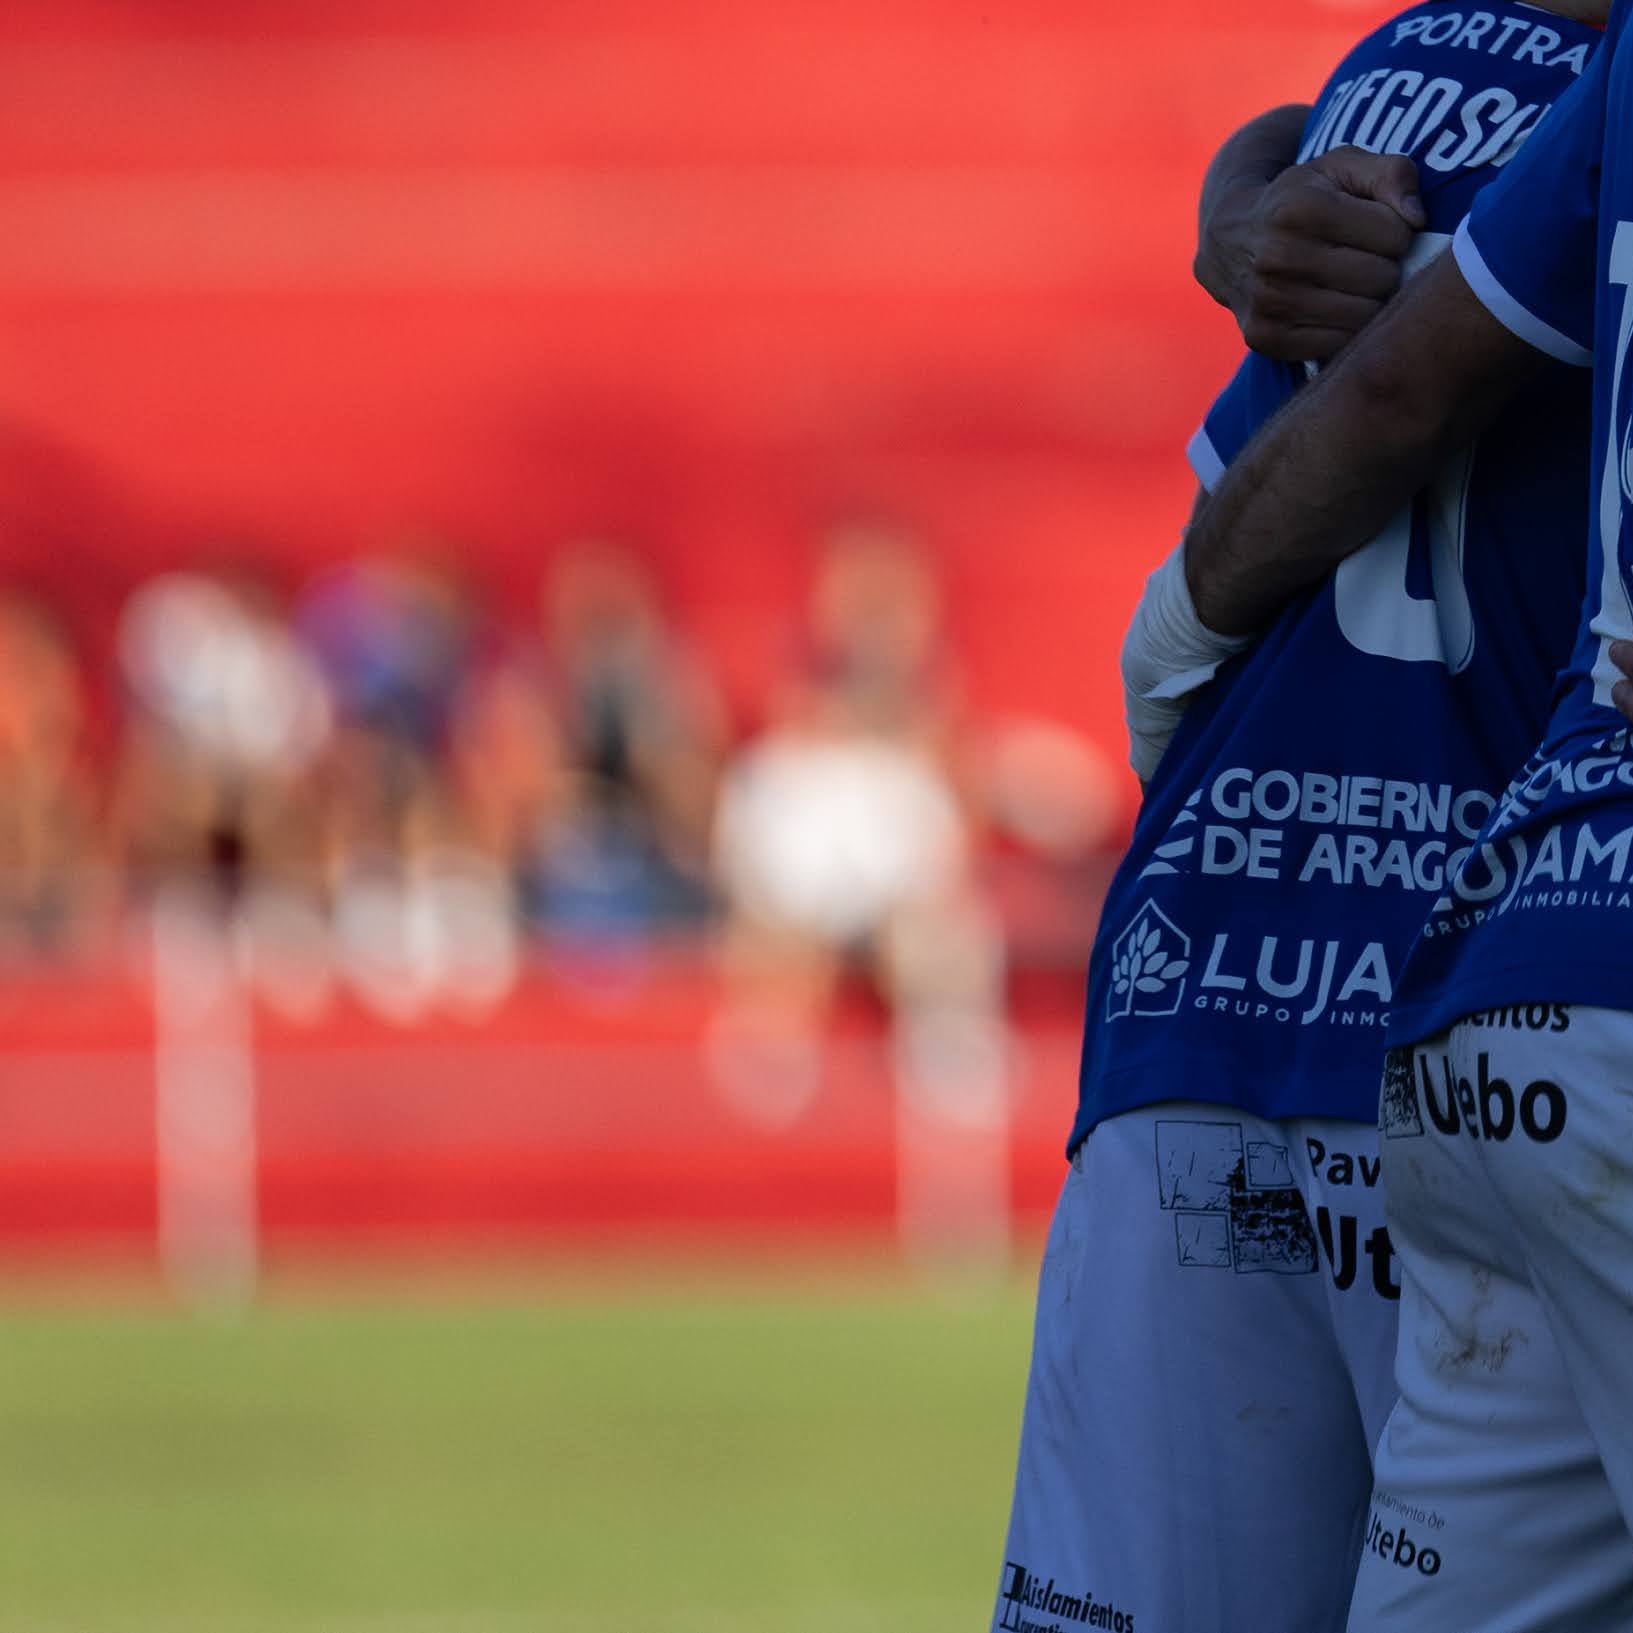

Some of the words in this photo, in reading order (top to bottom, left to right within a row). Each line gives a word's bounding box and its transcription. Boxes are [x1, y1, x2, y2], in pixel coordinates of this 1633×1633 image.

[1389, 10, 1591, 77] PORTRA
[1210, 766, 1498, 841] GOBIERNO
[1200, 824, 1284, 881] DE
[1193, 994, 1291, 1024] GRUPO
[1199, 932, 1393, 1025] LUJA
